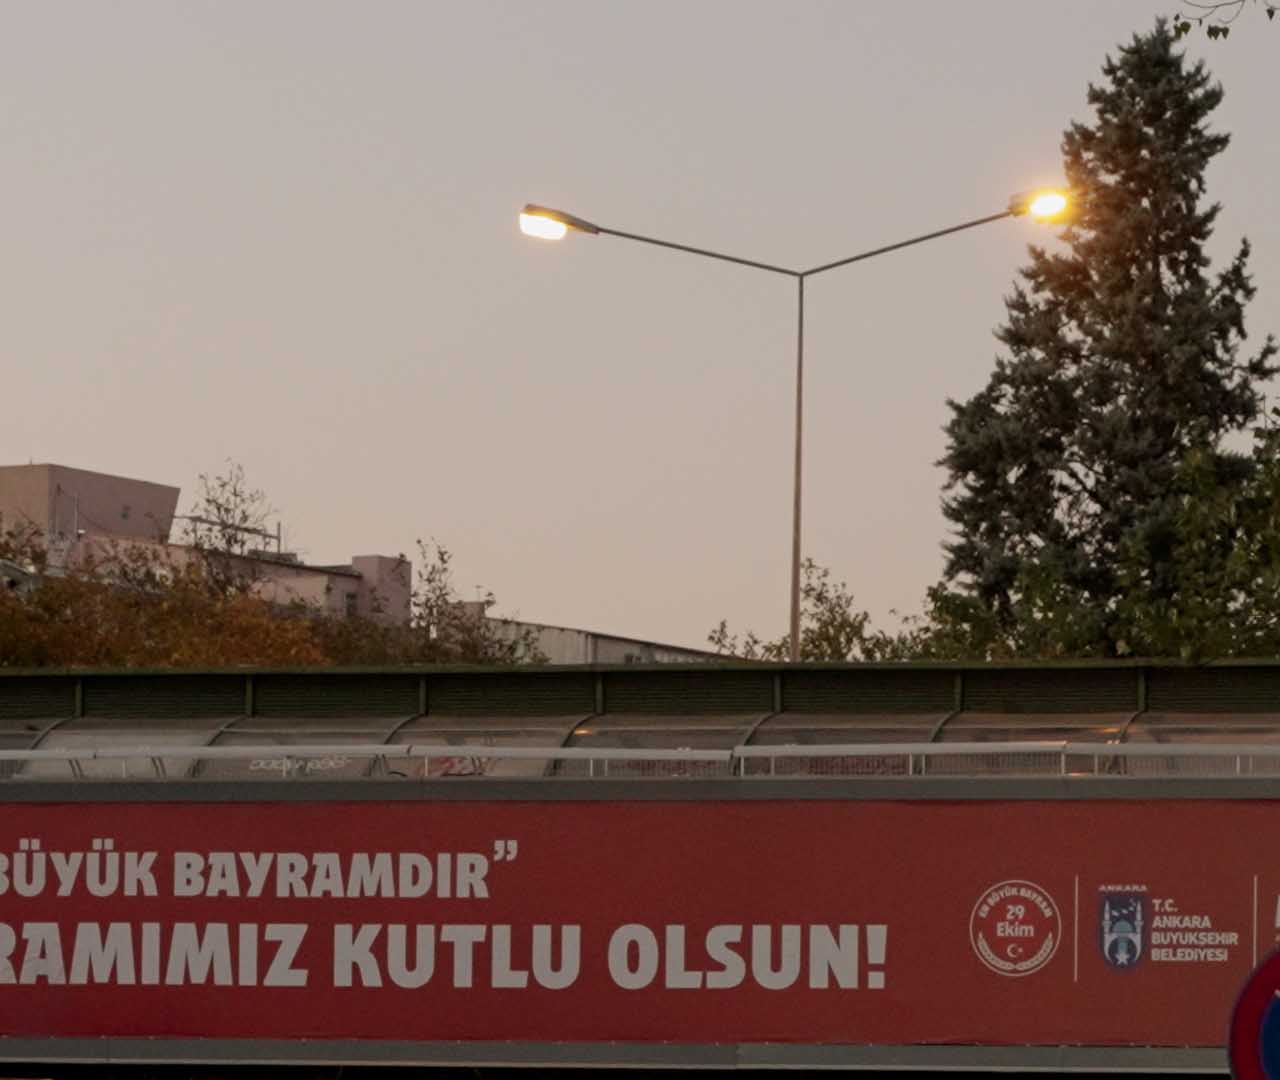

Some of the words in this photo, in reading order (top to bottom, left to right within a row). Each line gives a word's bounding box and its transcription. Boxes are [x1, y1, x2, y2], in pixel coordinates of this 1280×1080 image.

[1006, 904, 1025, 920] 29
[1152, 899, 1178, 912] T.C.
[996, 921, 1034, 937] Ekim
[1152, 915, 1211, 929] ANKARA
[333, 923, 581, 989] KUTLU
[608, 923, 888, 990] OLSUN!
